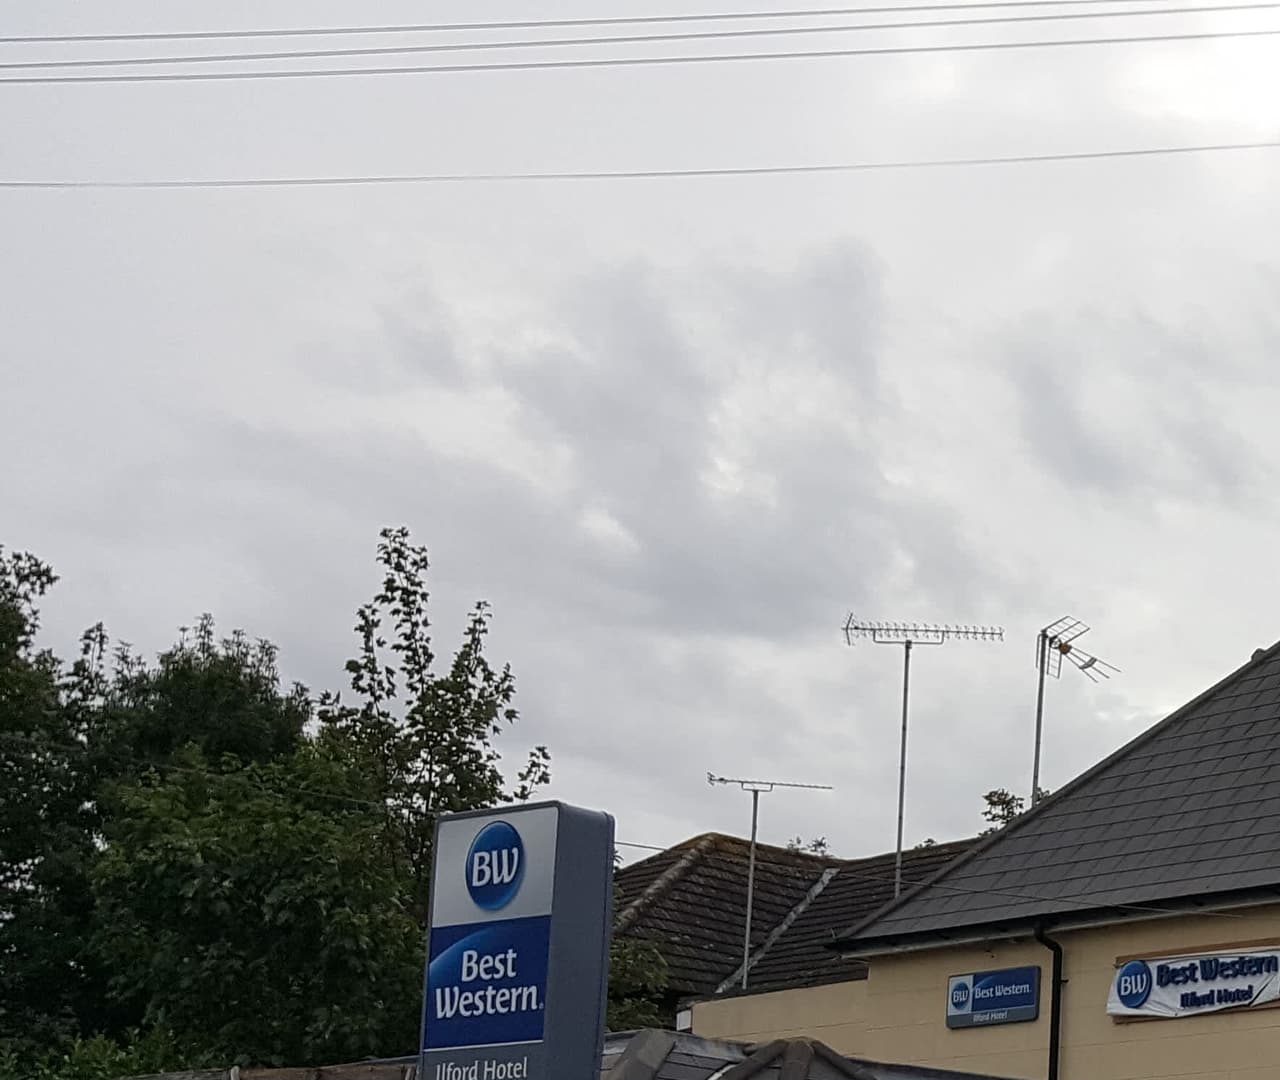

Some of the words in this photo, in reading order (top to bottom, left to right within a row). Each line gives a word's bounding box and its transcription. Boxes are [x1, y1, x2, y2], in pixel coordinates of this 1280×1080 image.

[472, 847, 519, 887] BW
[461, 949, 517, 982] Best
[1156, 962, 1198, 987] Best
[1200, 955, 1279, 981] Western
[953, 990, 968, 1003] BW
[974, 986, 994, 999] Best
[995, 983, 1030, 996] Western
[1121, 973, 1147, 996] BW
[435, 986, 539, 1019] Western
[483, 1056, 528, 1080] Hotel
